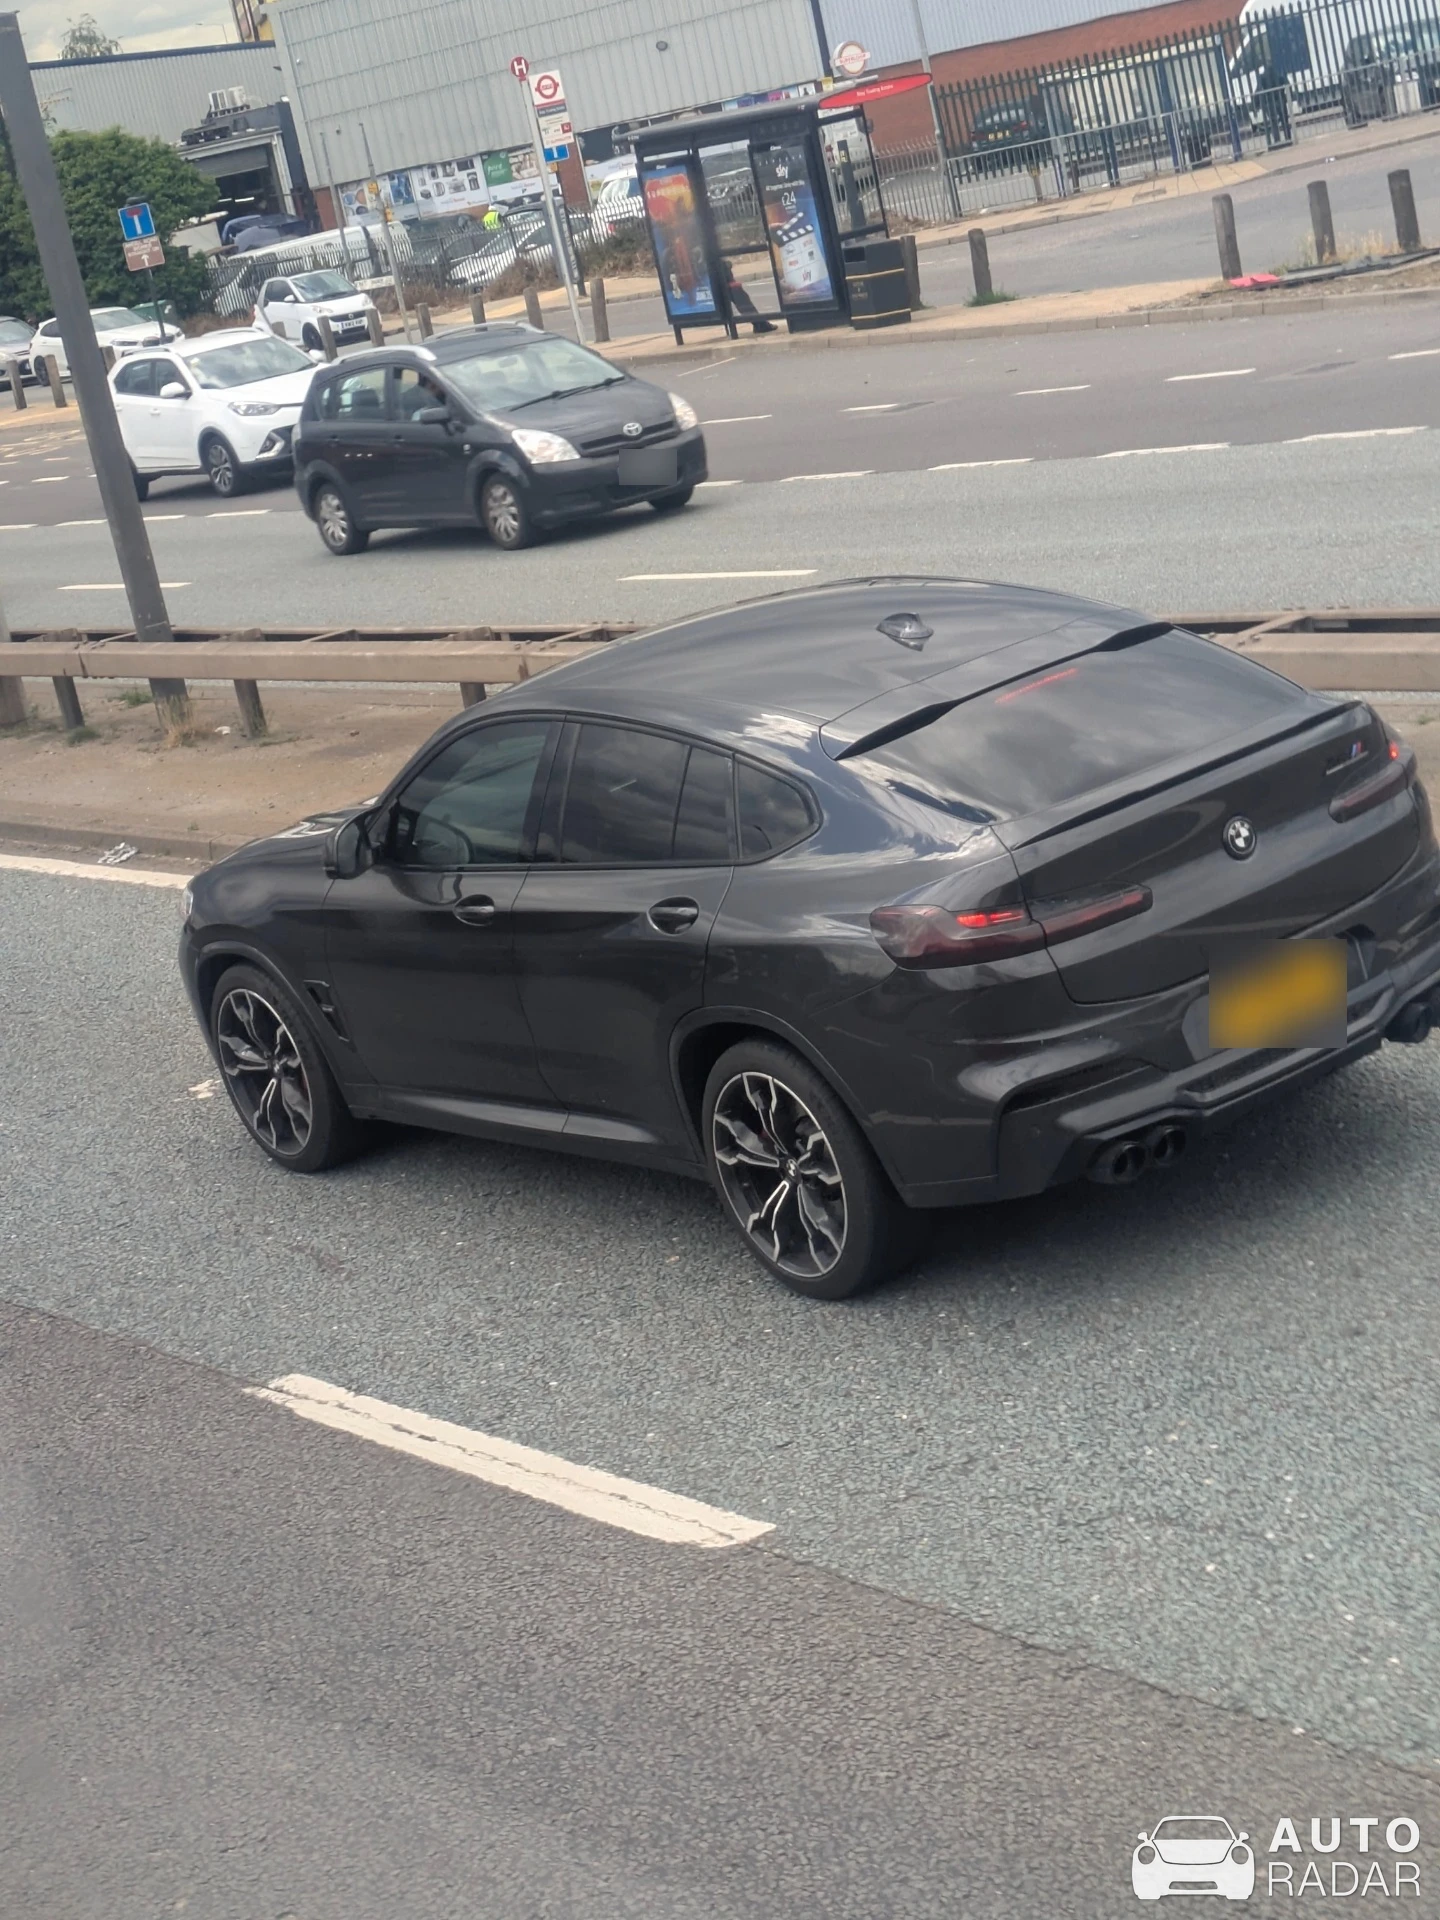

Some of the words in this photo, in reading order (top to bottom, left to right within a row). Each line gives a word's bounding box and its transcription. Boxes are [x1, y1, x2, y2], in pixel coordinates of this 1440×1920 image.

[513, 59, 527, 76] H
[775, 164, 789, 179] sky
[781, 191, 797, 207] £24
